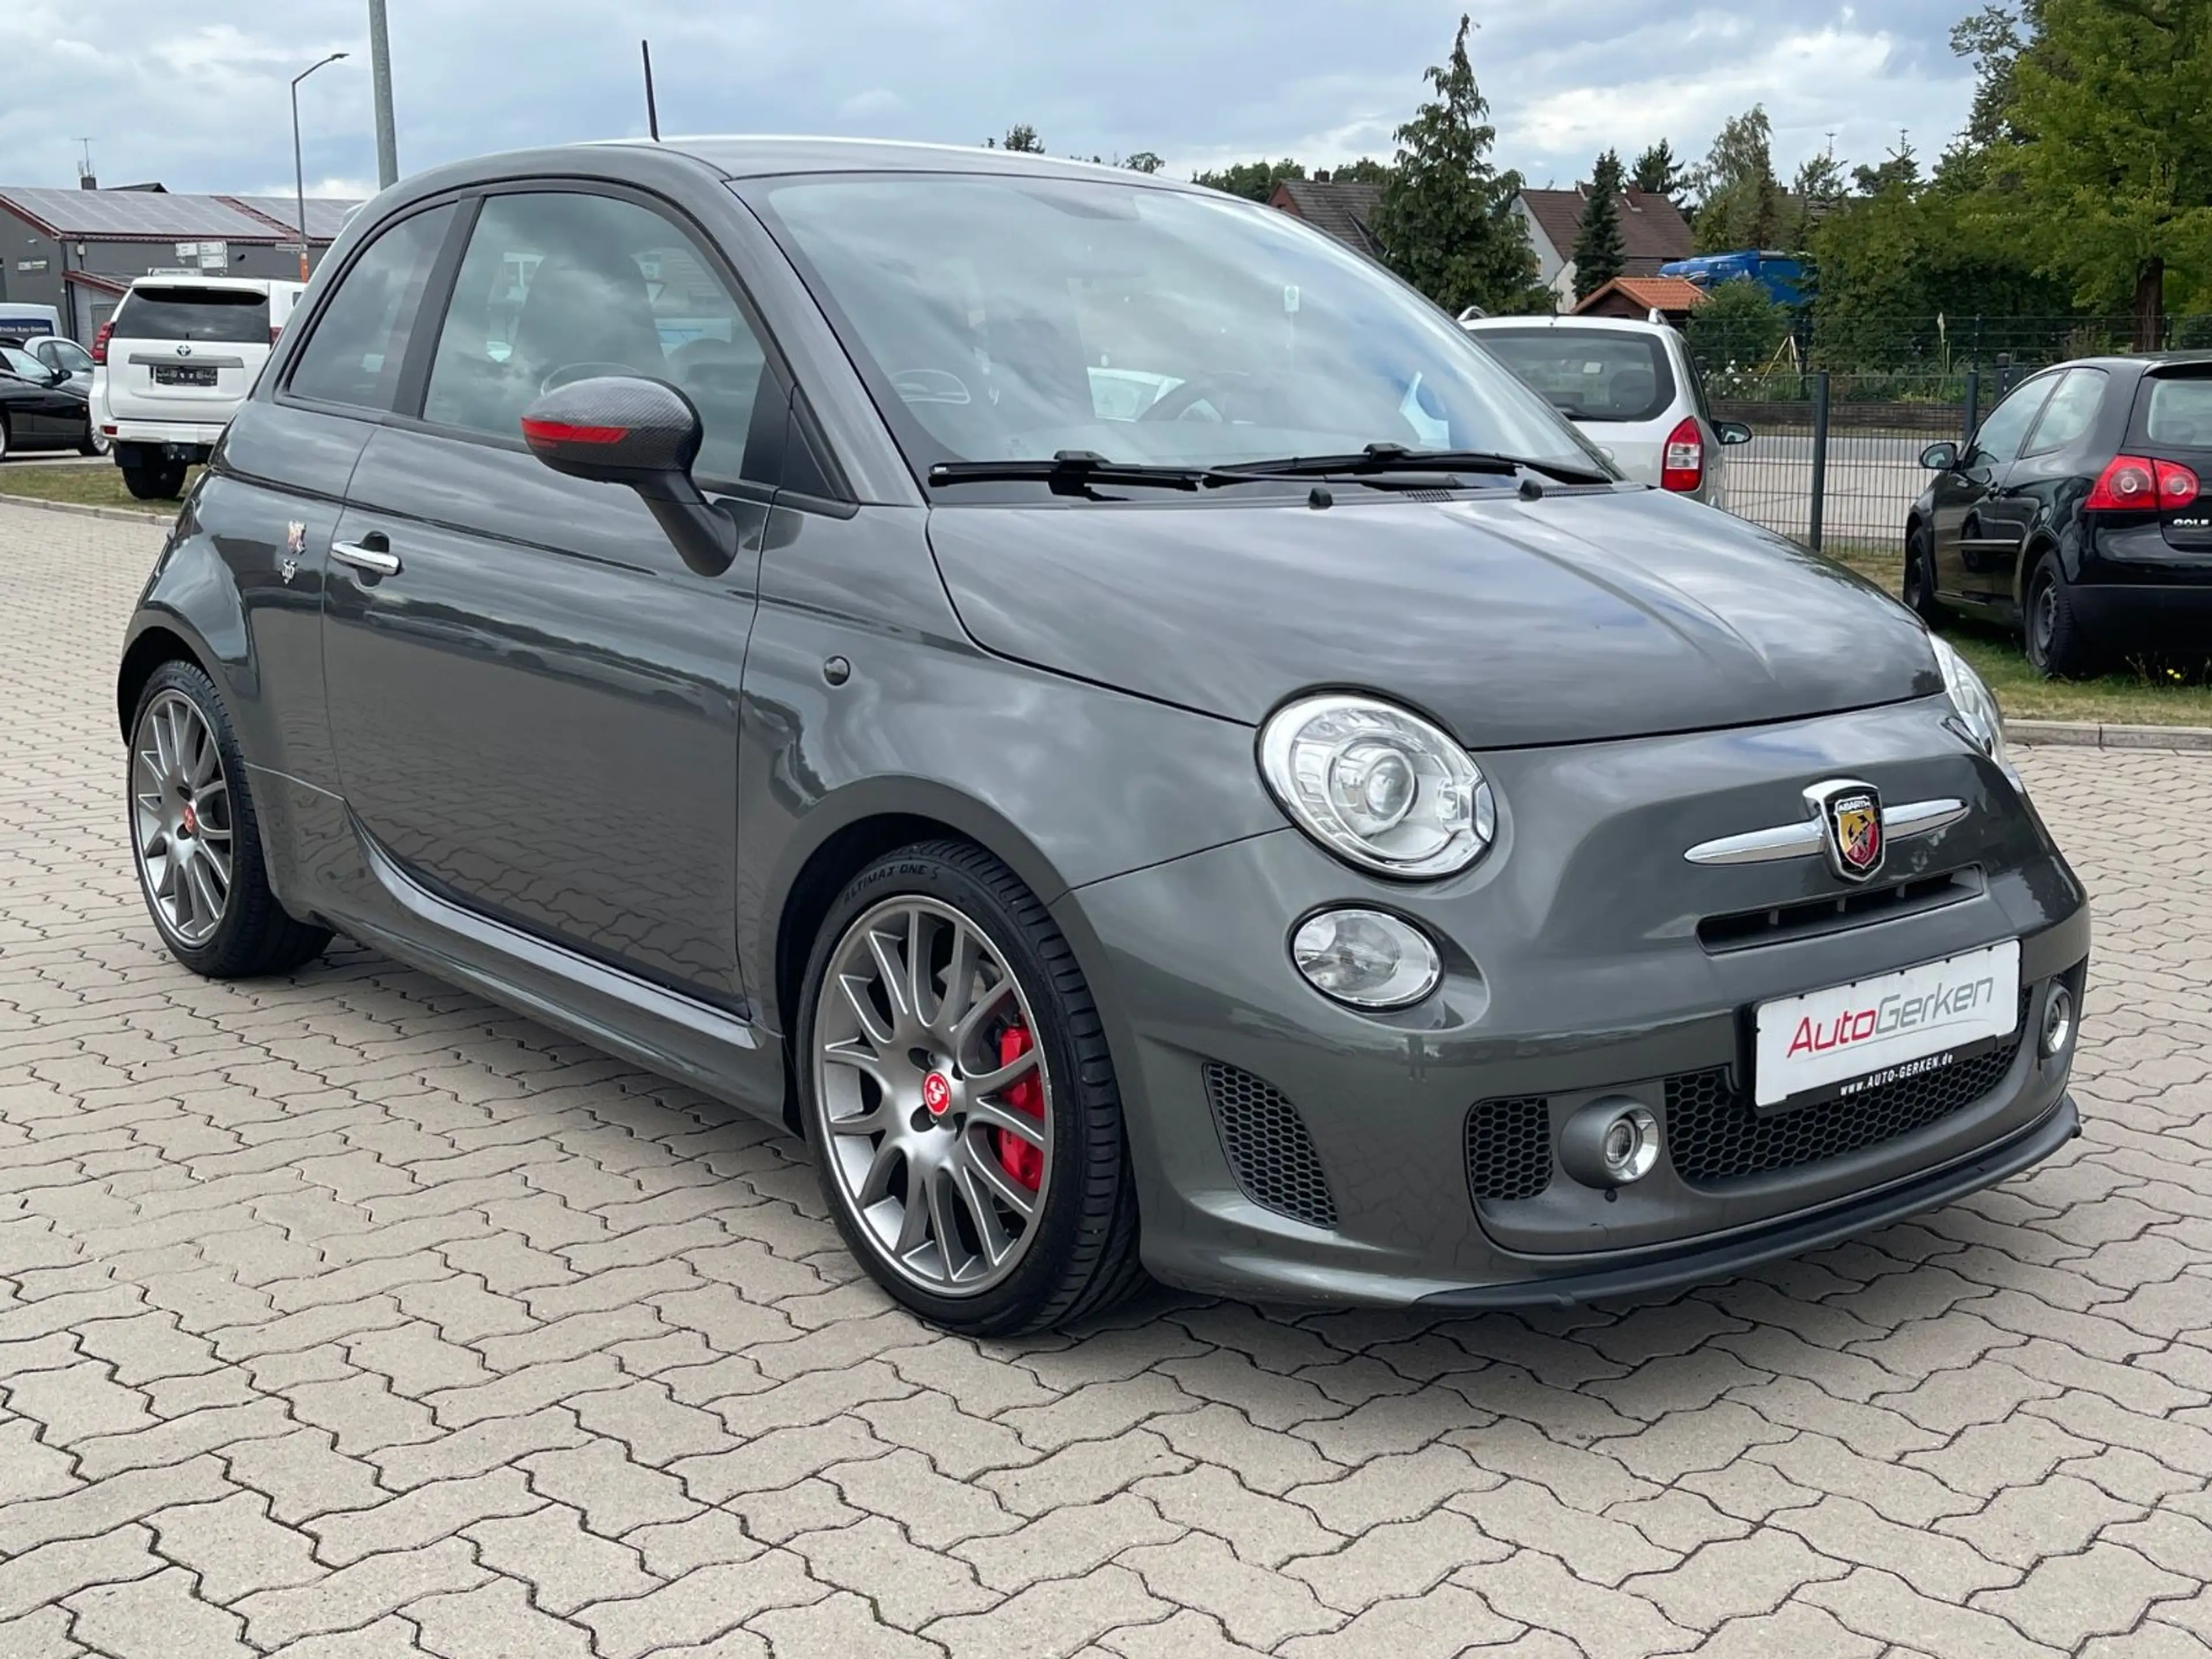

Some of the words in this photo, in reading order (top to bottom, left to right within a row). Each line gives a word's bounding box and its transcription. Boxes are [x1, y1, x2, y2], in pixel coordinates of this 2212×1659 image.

[899, 865, 928, 874] ONE
[930, 867, 940, 880] S
[1787, 978, 1993, 1058] AutoGerken
[1840, 1052, 1953, 1096] www.AUTO-GERKEN.de
